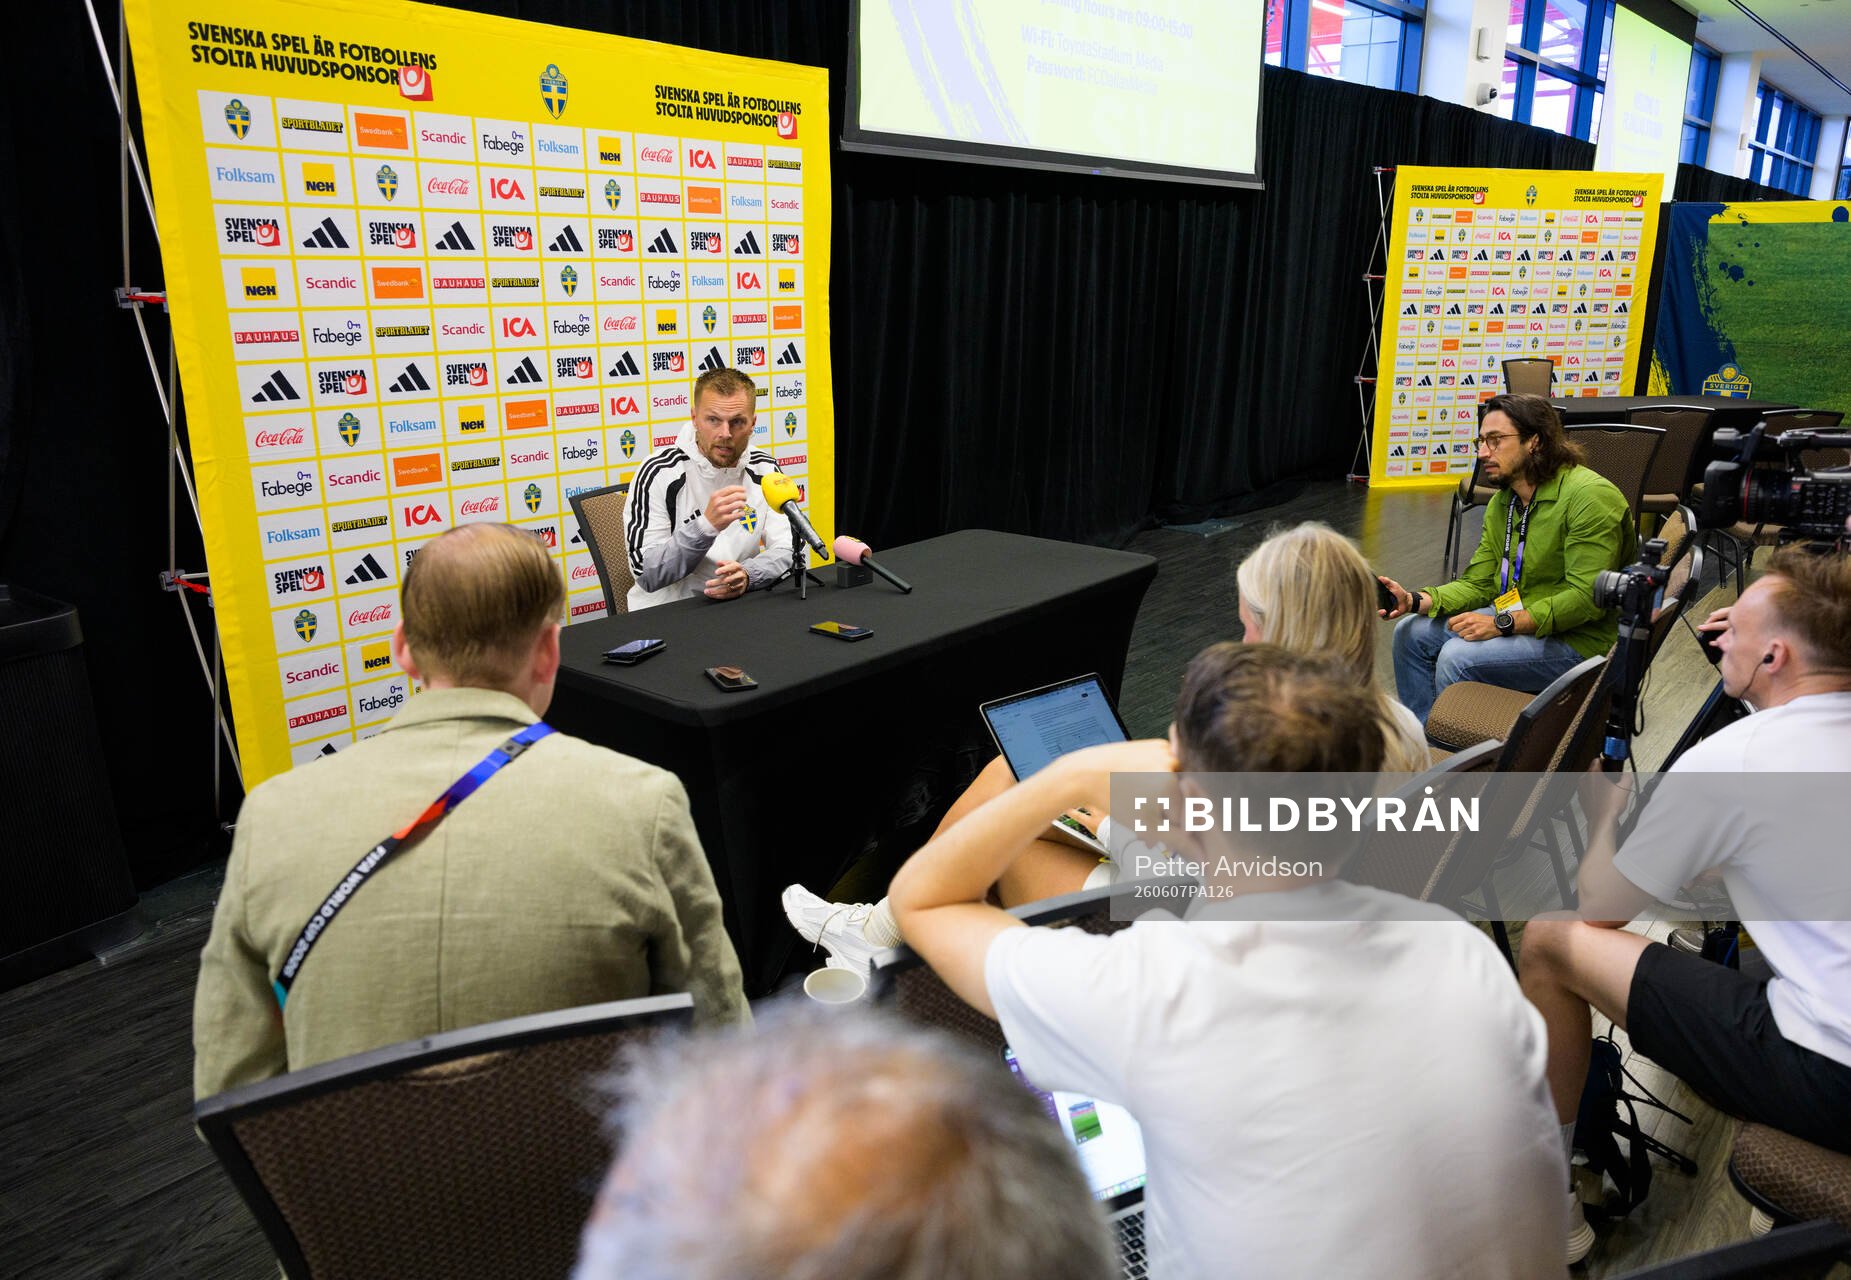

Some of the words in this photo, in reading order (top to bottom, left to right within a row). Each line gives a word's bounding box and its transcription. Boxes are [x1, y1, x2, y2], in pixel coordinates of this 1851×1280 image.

[188, 21, 268, 49] SVENSKA
[271, 33, 310, 54] SPEL
[314, 34, 336, 58] ÄR
[339, 42, 437, 70] FOTBOLLENS
[192, 44, 257, 70] STOLTA
[260, 52, 400, 86] HUVUDSPONSOR
[655, 84, 700, 104] SVENSKA
[703, 91, 725, 107] SPEL
[728, 92, 740, 108] ÄR
[743, 96, 802, 115] FOTBOLLENS
[656, 102, 694, 120] STOLTA
[696, 107, 778, 128] HUVUDSPONSOR
[282, 117, 343, 134] SPORTBLADET
[359, 126, 394, 136] Swedbank
[422, 130, 466, 145] Scandic
[483, 134, 524, 155] Fabege
[538, 140, 580, 155] Folksam
[690, 149, 717, 170] ICA
[728, 156, 763, 168] BAUHAUS
[216, 166, 276, 184] Folksam
[490, 178, 526, 200] ICA
[540, 186, 585, 198] SPORTBLADET
[640, 193, 680, 204] BAUHAUS
[732, 196, 762, 208] Folksam
[771, 200, 800, 210] Scandic
[225, 218, 279, 231] SVENSKA
[1585, 215, 1598, 223] ICA
[370, 222, 415, 234] SVENSKA
[493, 226, 532, 237] SVENSKA
[227, 231, 256, 243] SPEL
[371, 234, 395, 246] SPEL
[598, 229, 632, 240] SVENSKA
[690, 232, 722, 242] SVENSKA
[772, 234, 800, 244] SVENSKA
[1498, 232, 1511, 240] ICA
[494, 236, 514, 248] SPEL
[599, 238, 618, 249] SPEL
[691, 241, 707, 251] SPEL
[773, 243, 788, 252] SPEL
[1600, 269, 1612, 278] ICA
[306, 276, 357, 290] Scandic
[376, 279, 410, 288] Swedbank
[434, 278, 485, 288] BAUHAUS
[492, 277, 540, 288] SPORTBLADET
[600, 276, 636, 286] Scandic
[648, 275, 680, 292] Fabege
[692, 275, 724, 286] Folksam
[736, 272, 761, 290] ICA
[1492, 287, 1505, 296] ICA
[732, 314, 767, 324] BAUHAUS
[375, 325, 430, 338] SPORTBLADET
[442, 324, 486, 336] Scandic
[502, 317, 536, 338] ICA
[554, 320, 590, 336] Fabege
[1530, 322, 1542, 331] ICA
[234, 330, 299, 344] BAUHAUS
[313, 328, 362, 346] Fabege
[652, 351, 684, 362] SVENSKA
[737, 346, 765, 356] SVENSKA
[556, 356, 593, 368] SVENSKA
[653, 360, 670, 372] SPEL
[738, 356, 752, 365] SPEL
[1442, 359, 1455, 368] ICA
[1568, 356, 1580, 364] ICA
[446, 362, 488, 374] SVENSKA
[558, 366, 576, 378] SPEL
[318, 370, 366, 382] SVENSKA
[447, 374, 468, 386] SPEL
[320, 382, 345, 394] SPEL
[776, 385, 802, 399] Fabege
[610, 396, 640, 416] ICA
[653, 394, 688, 407] Scandic
[556, 404, 600, 416] BAUHAUS
[1458, 410, 1470, 418] ICA
[389, 420, 436, 433] Folksam
[654, 436, 676, 447] BAUH
[510, 450, 550, 464] Scandic
[562, 445, 598, 460] Fabege
[452, 456, 500, 472] SPORTBLADET
[328, 470, 381, 486] Scandic
[262, 480, 312, 497] Fabege
[404, 504, 442, 527] ICA
[332, 516, 387, 532] SPORTBLADET
[267, 527, 320, 544] Folksam
[274, 566, 324, 583] SVENSKA
[276, 582, 302, 594] SPEL
[572, 601, 606, 616] BAUHAU
[286, 662, 340, 684] Scandic
[360, 692, 404, 712] Fabege
[289, 704, 347, 728] BAUHAUS
[356, 845, 386, 873] FIFA
[321, 872, 363, 918] WORLD
[304, 916, 326, 942] CUP
